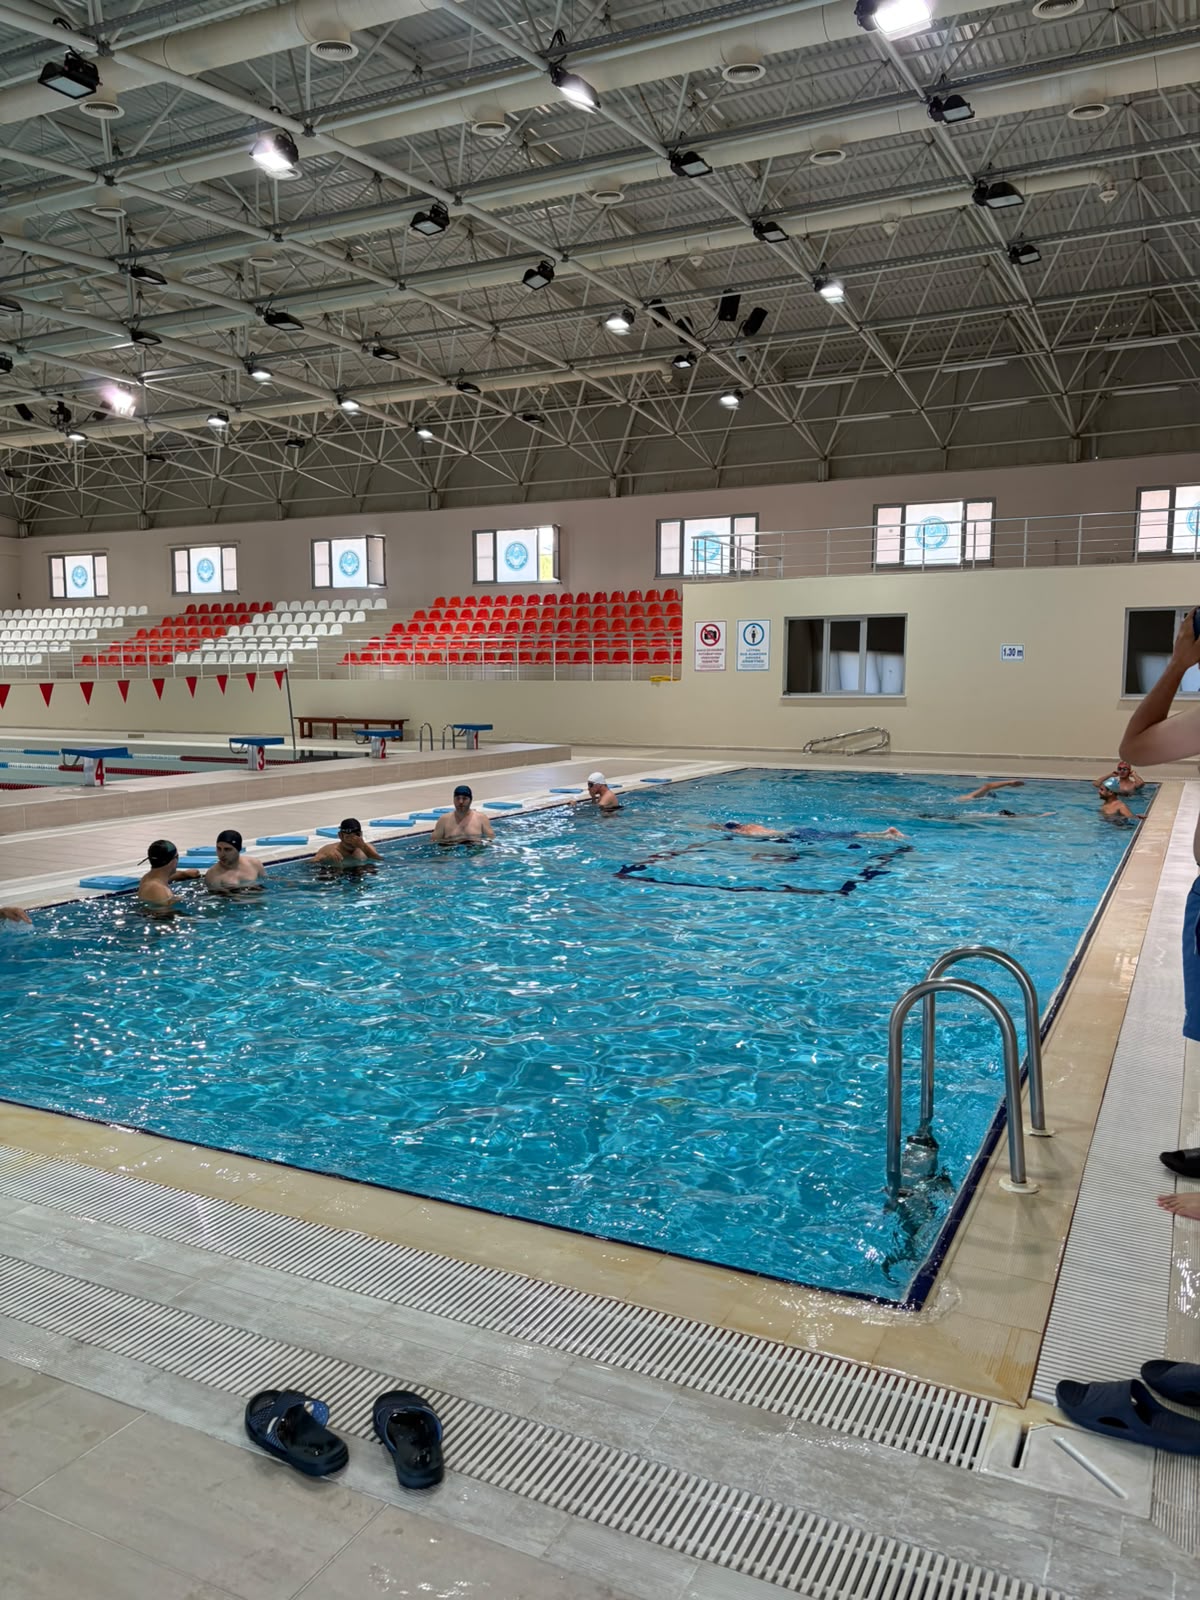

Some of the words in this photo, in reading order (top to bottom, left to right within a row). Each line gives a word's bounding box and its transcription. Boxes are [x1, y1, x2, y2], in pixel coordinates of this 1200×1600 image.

[1003, 647, 1016, 657] 1.30
[1017, 649, 1023, 657] m
[257, 746, 265, 770] 3
[380, 737, 386, 760] 2
[95, 758, 105, 785] 4
